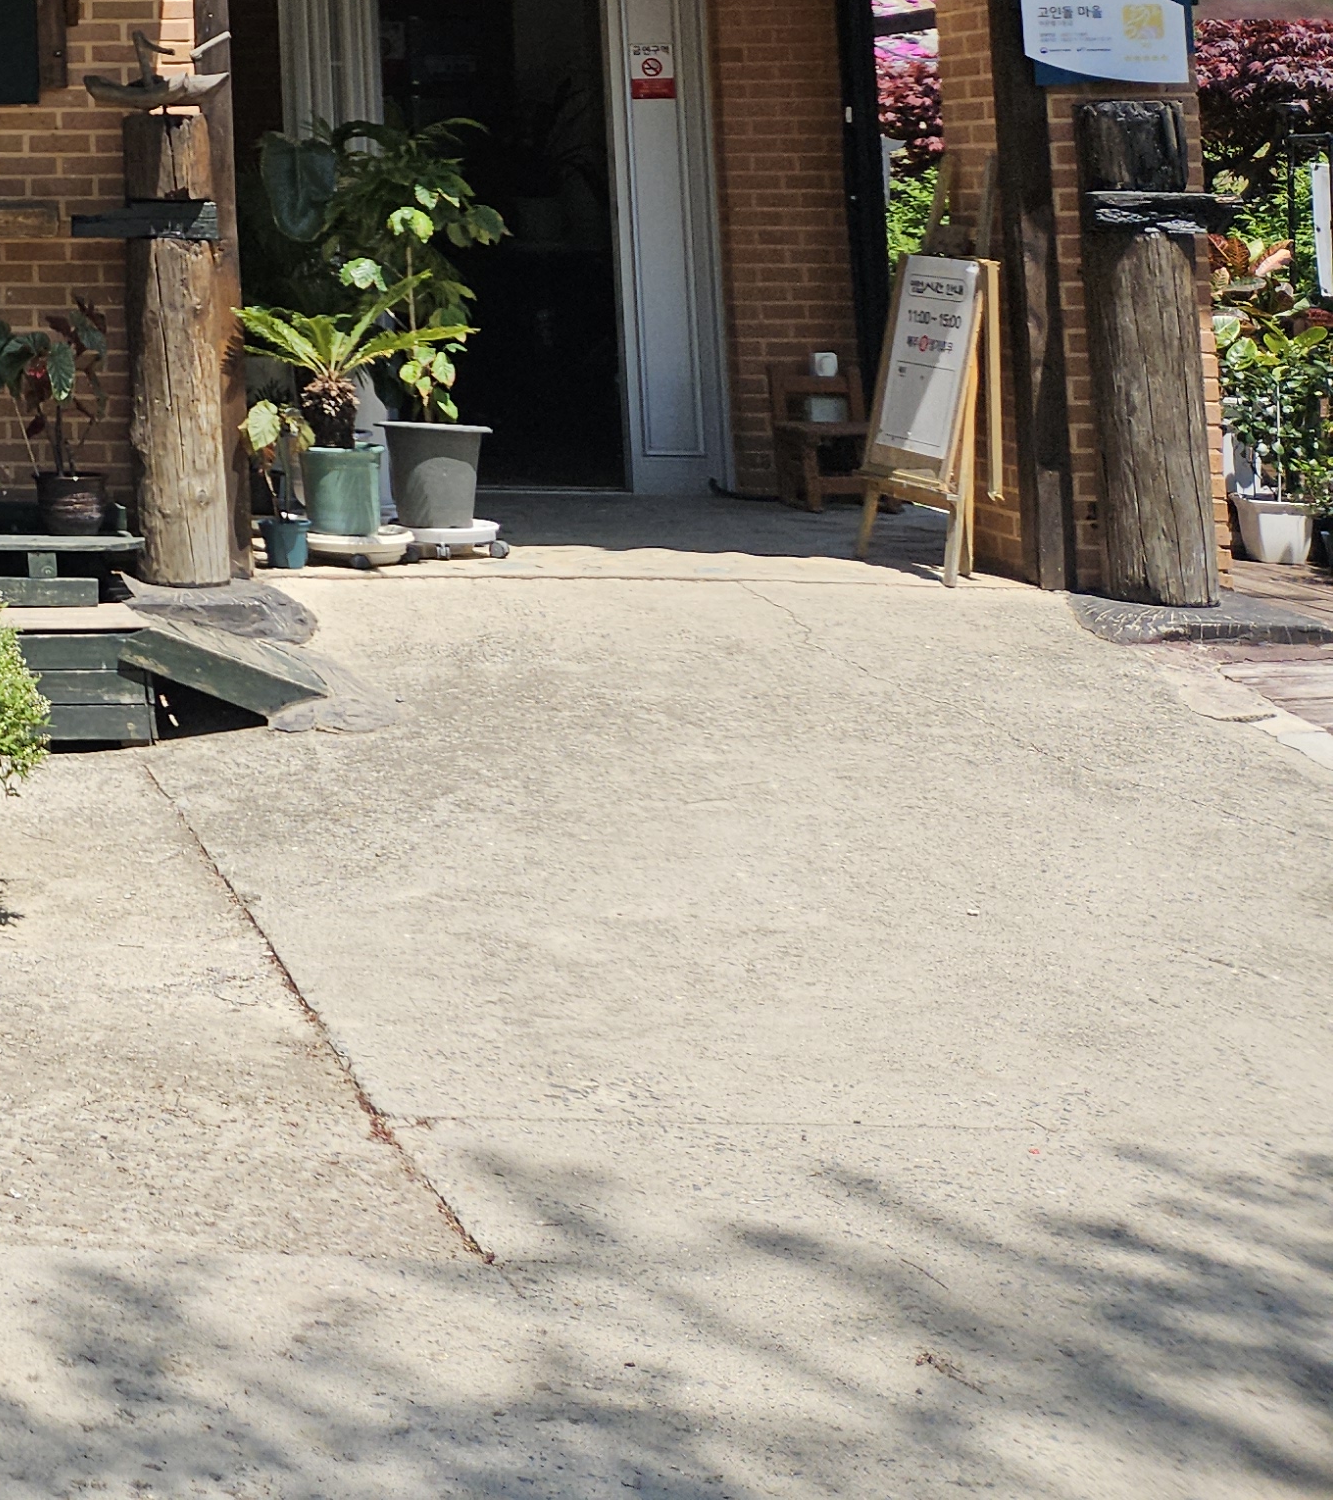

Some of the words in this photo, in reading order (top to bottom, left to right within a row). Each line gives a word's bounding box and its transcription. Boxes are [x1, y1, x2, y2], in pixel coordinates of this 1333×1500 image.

[1037, 5, 1074, 20] 고인돌
[1077, 4, 1103, 19] 마을
[633, 45, 670, 56] 금연구역
